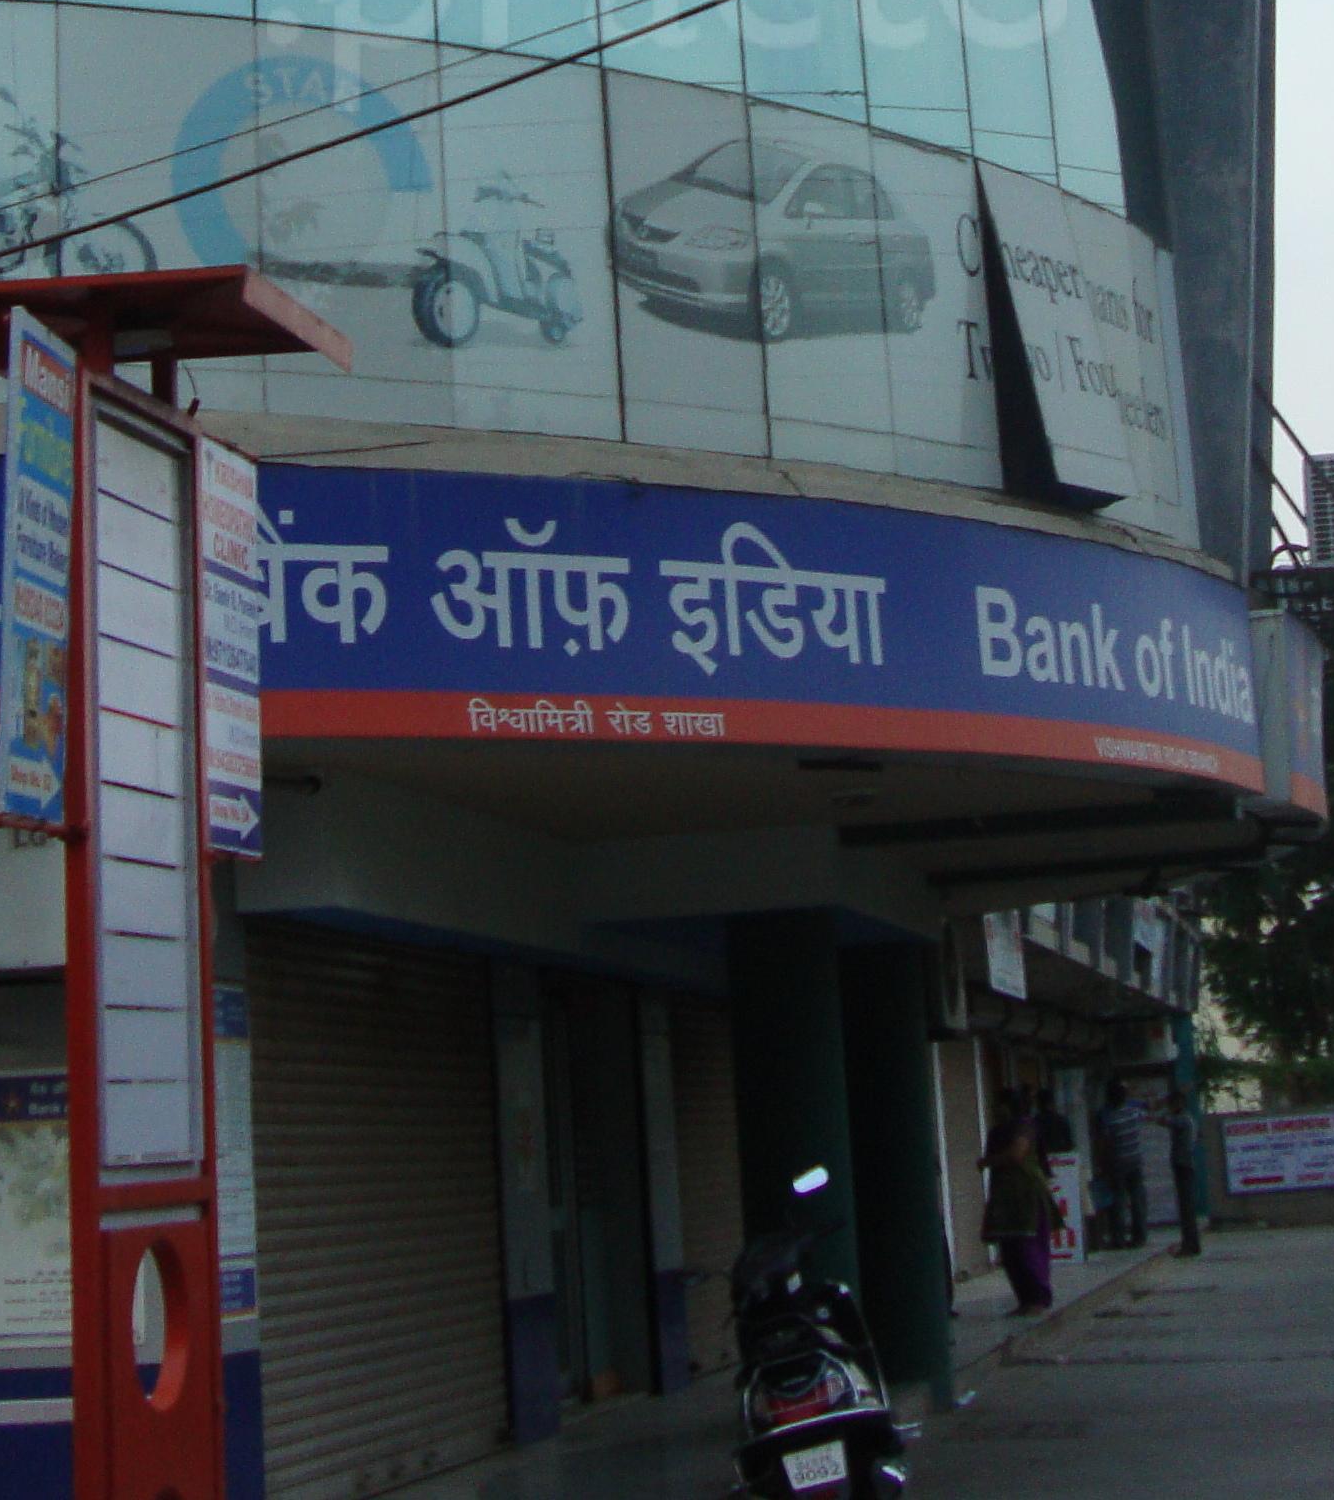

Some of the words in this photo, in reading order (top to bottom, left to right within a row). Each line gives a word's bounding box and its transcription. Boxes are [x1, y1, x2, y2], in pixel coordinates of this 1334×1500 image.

[1066, 335, 1120, 399] Fou
[975, 585, 1125, 692] Bank
[1135, 617, 1175, 700] of
[1181, 623, 1256, 725] India
[468, 697, 595, 734] विश्वामित्री
[605, 701, 652, 735] रोड
[661, 711, 726, 737] शाखा
